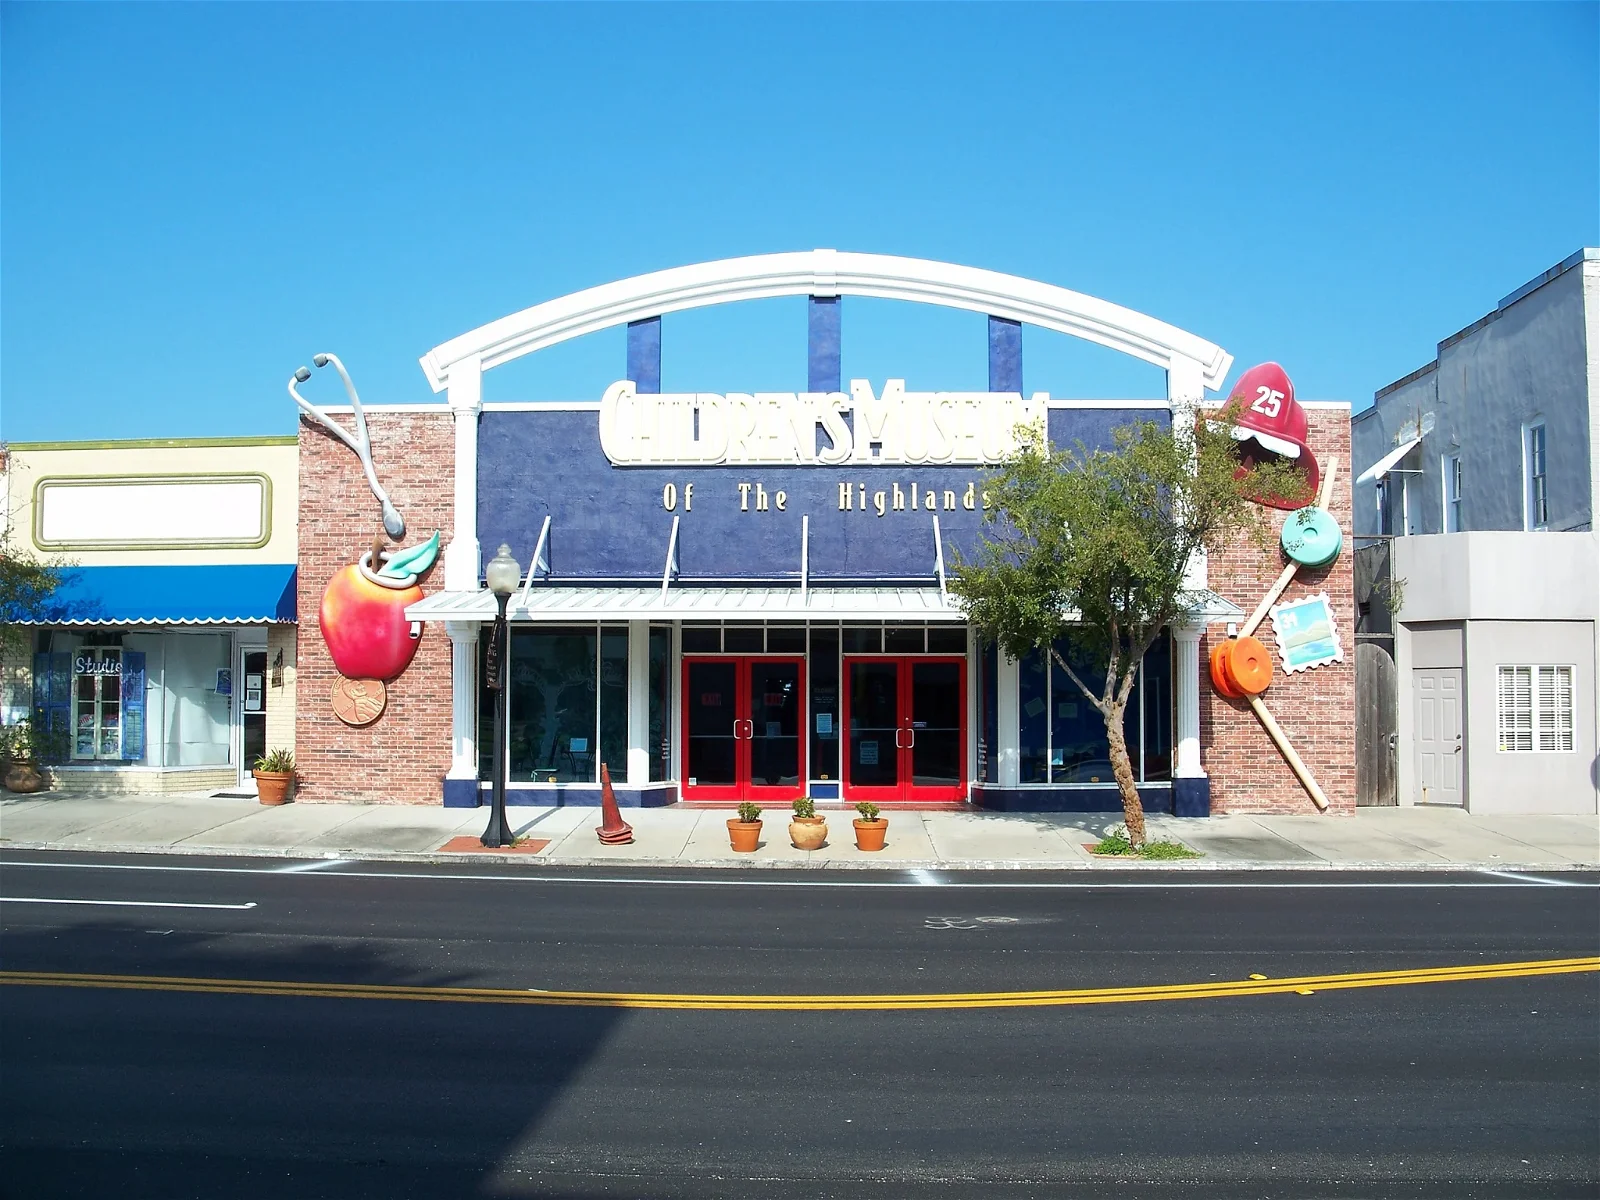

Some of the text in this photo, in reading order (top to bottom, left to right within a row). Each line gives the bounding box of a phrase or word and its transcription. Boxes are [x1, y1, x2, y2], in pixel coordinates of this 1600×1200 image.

[1250, 385, 1285, 418] 25
[851, 379, 1049, 464] MUSEUM
[663, 482, 992, 517] Of The Highlands
[76, 657, 123, 673] Studio
